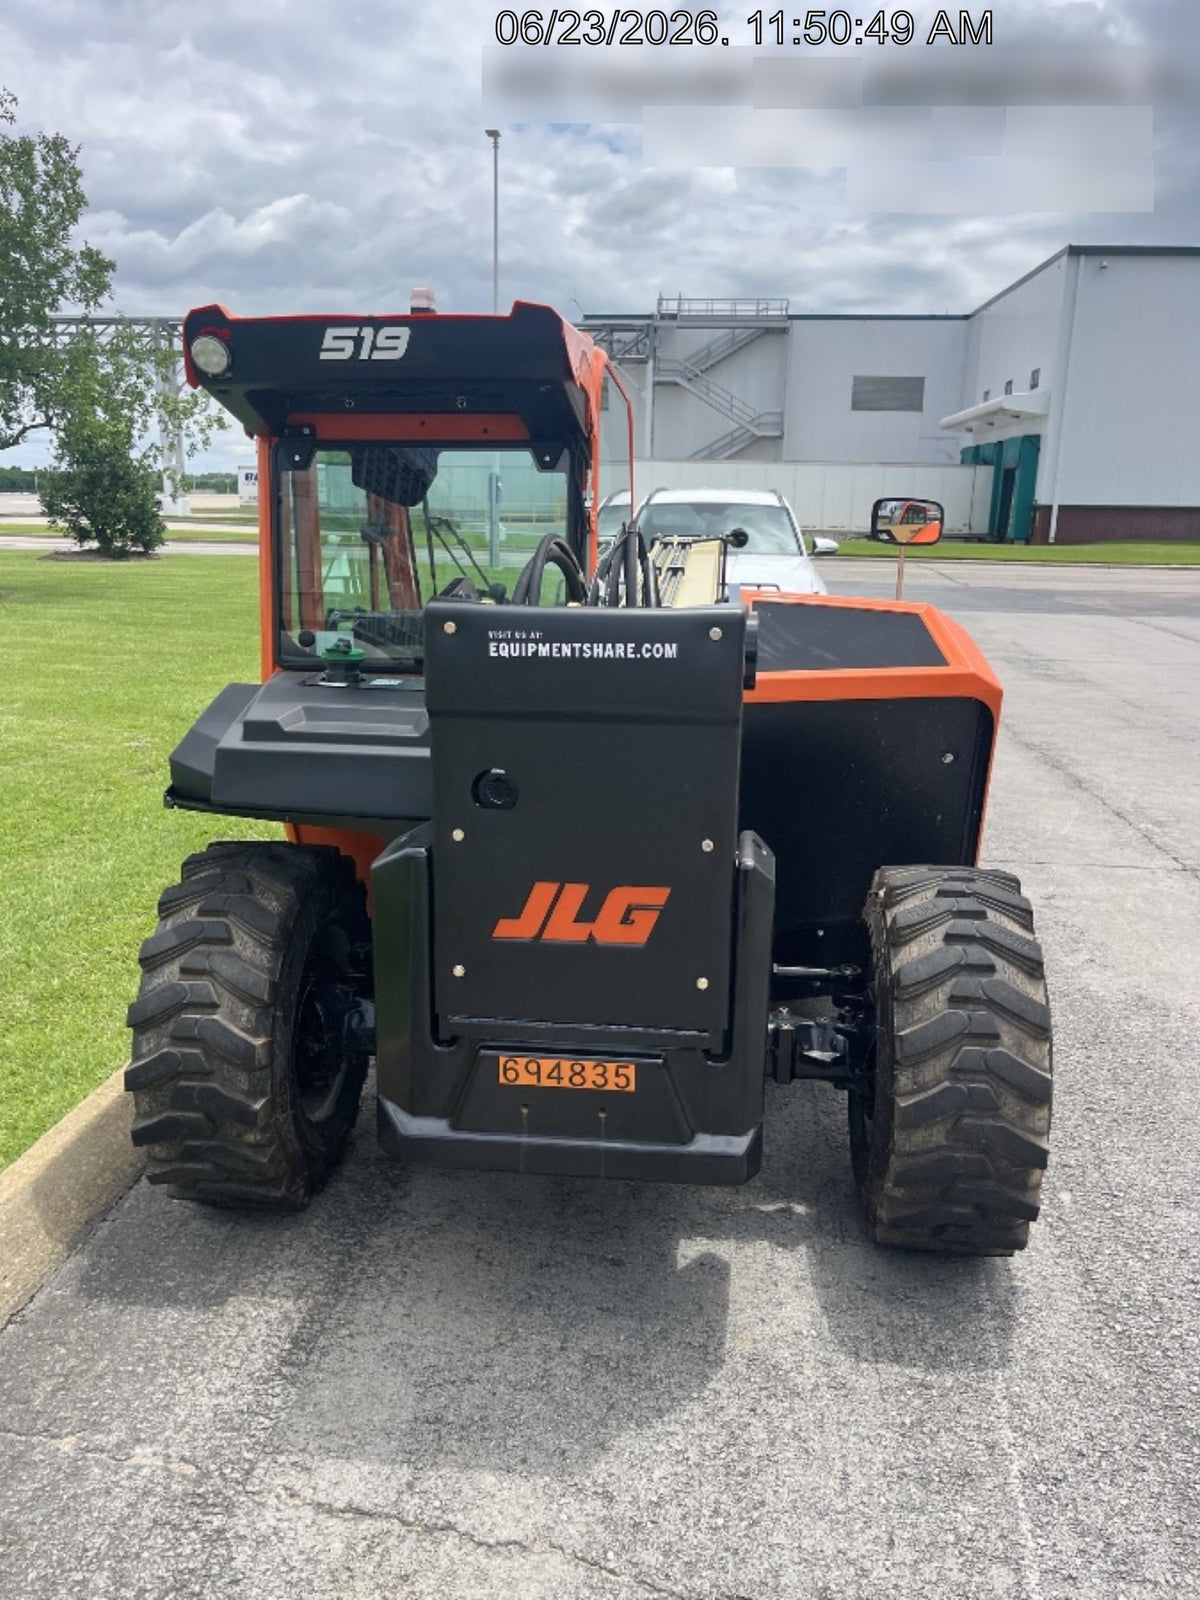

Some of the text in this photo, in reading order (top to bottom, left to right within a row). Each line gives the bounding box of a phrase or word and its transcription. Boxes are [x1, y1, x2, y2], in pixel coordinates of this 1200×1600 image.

[320, 326, 411, 360] 519
[488, 630, 543, 639] VISIT US AT:
[489, 642, 678, 659] EQUIPMENTSHARE.COM
[491, 881, 672, 945] JLG
[502, 1058, 631, 1089] 694835
